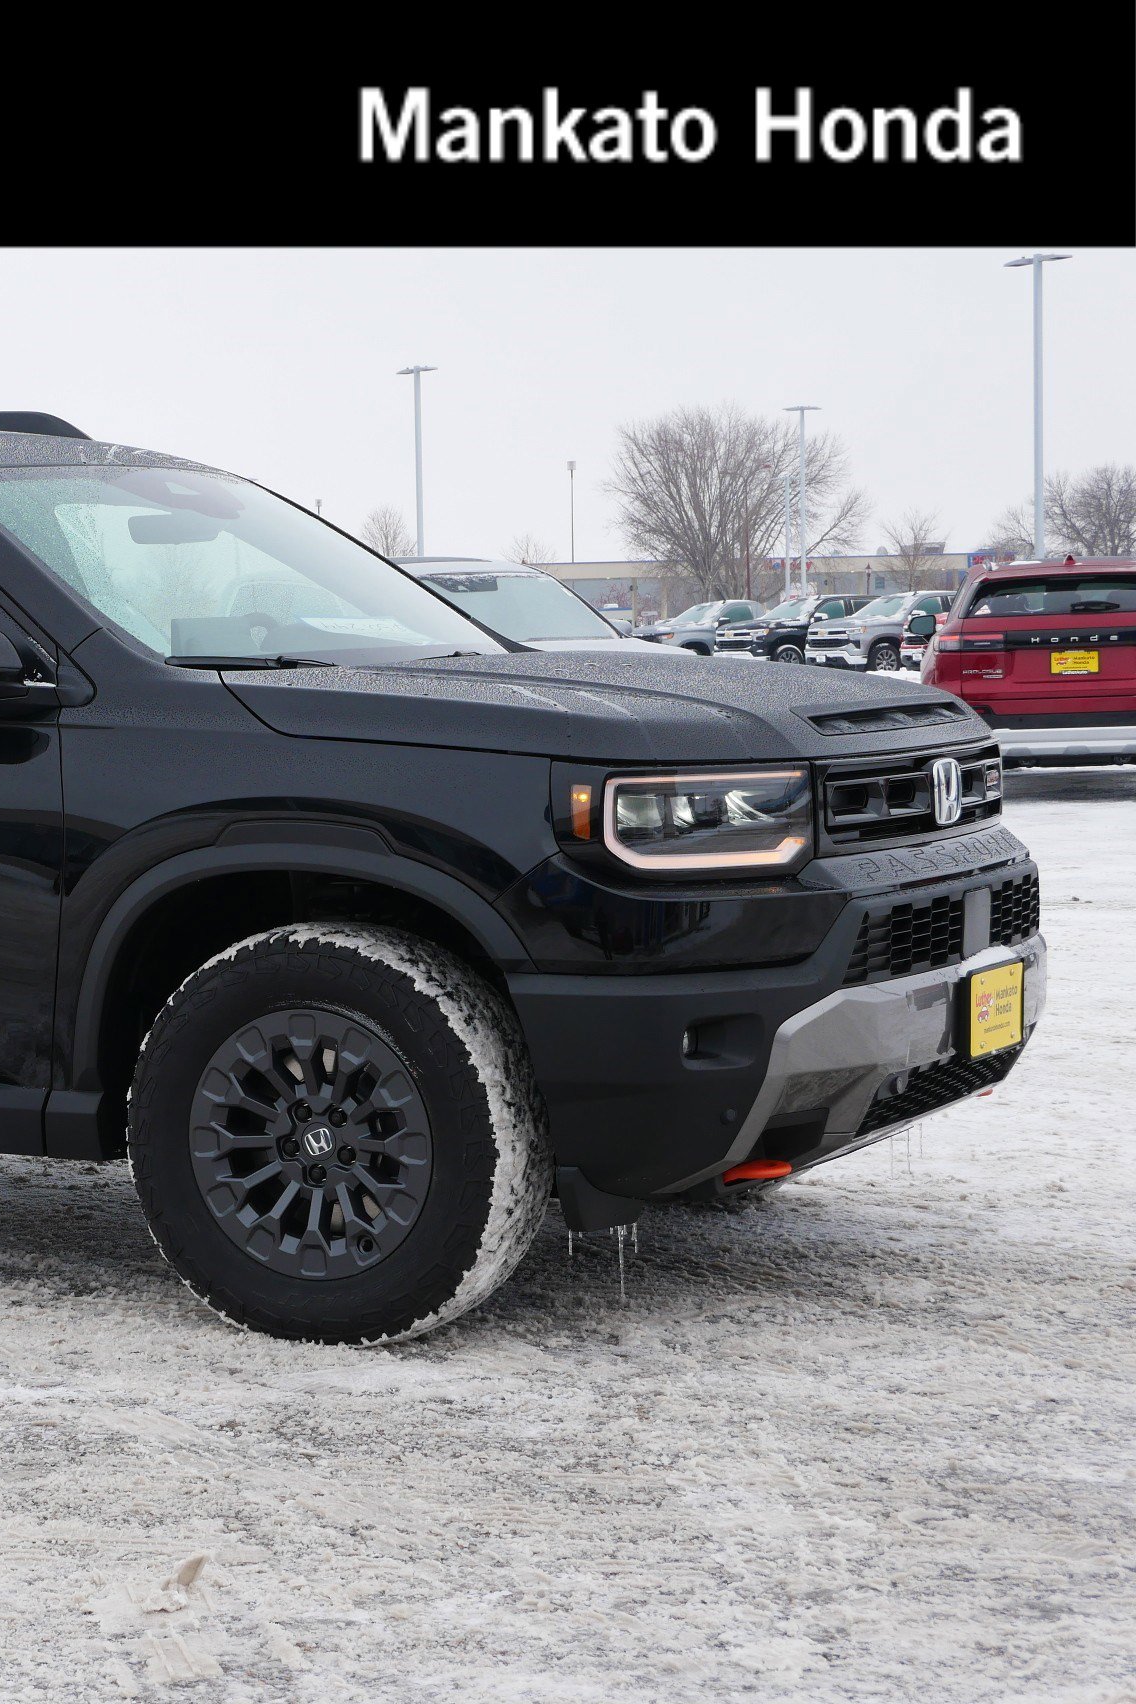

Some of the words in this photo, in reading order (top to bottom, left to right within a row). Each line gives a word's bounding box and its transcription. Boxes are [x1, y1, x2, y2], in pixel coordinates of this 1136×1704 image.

[850, 829, 1018, 882] PASSPORT
[975, 991, 993, 1008] Luther
[995, 985, 1018, 1001] Mankato
[995, 1000, 1012, 1017] Honda
